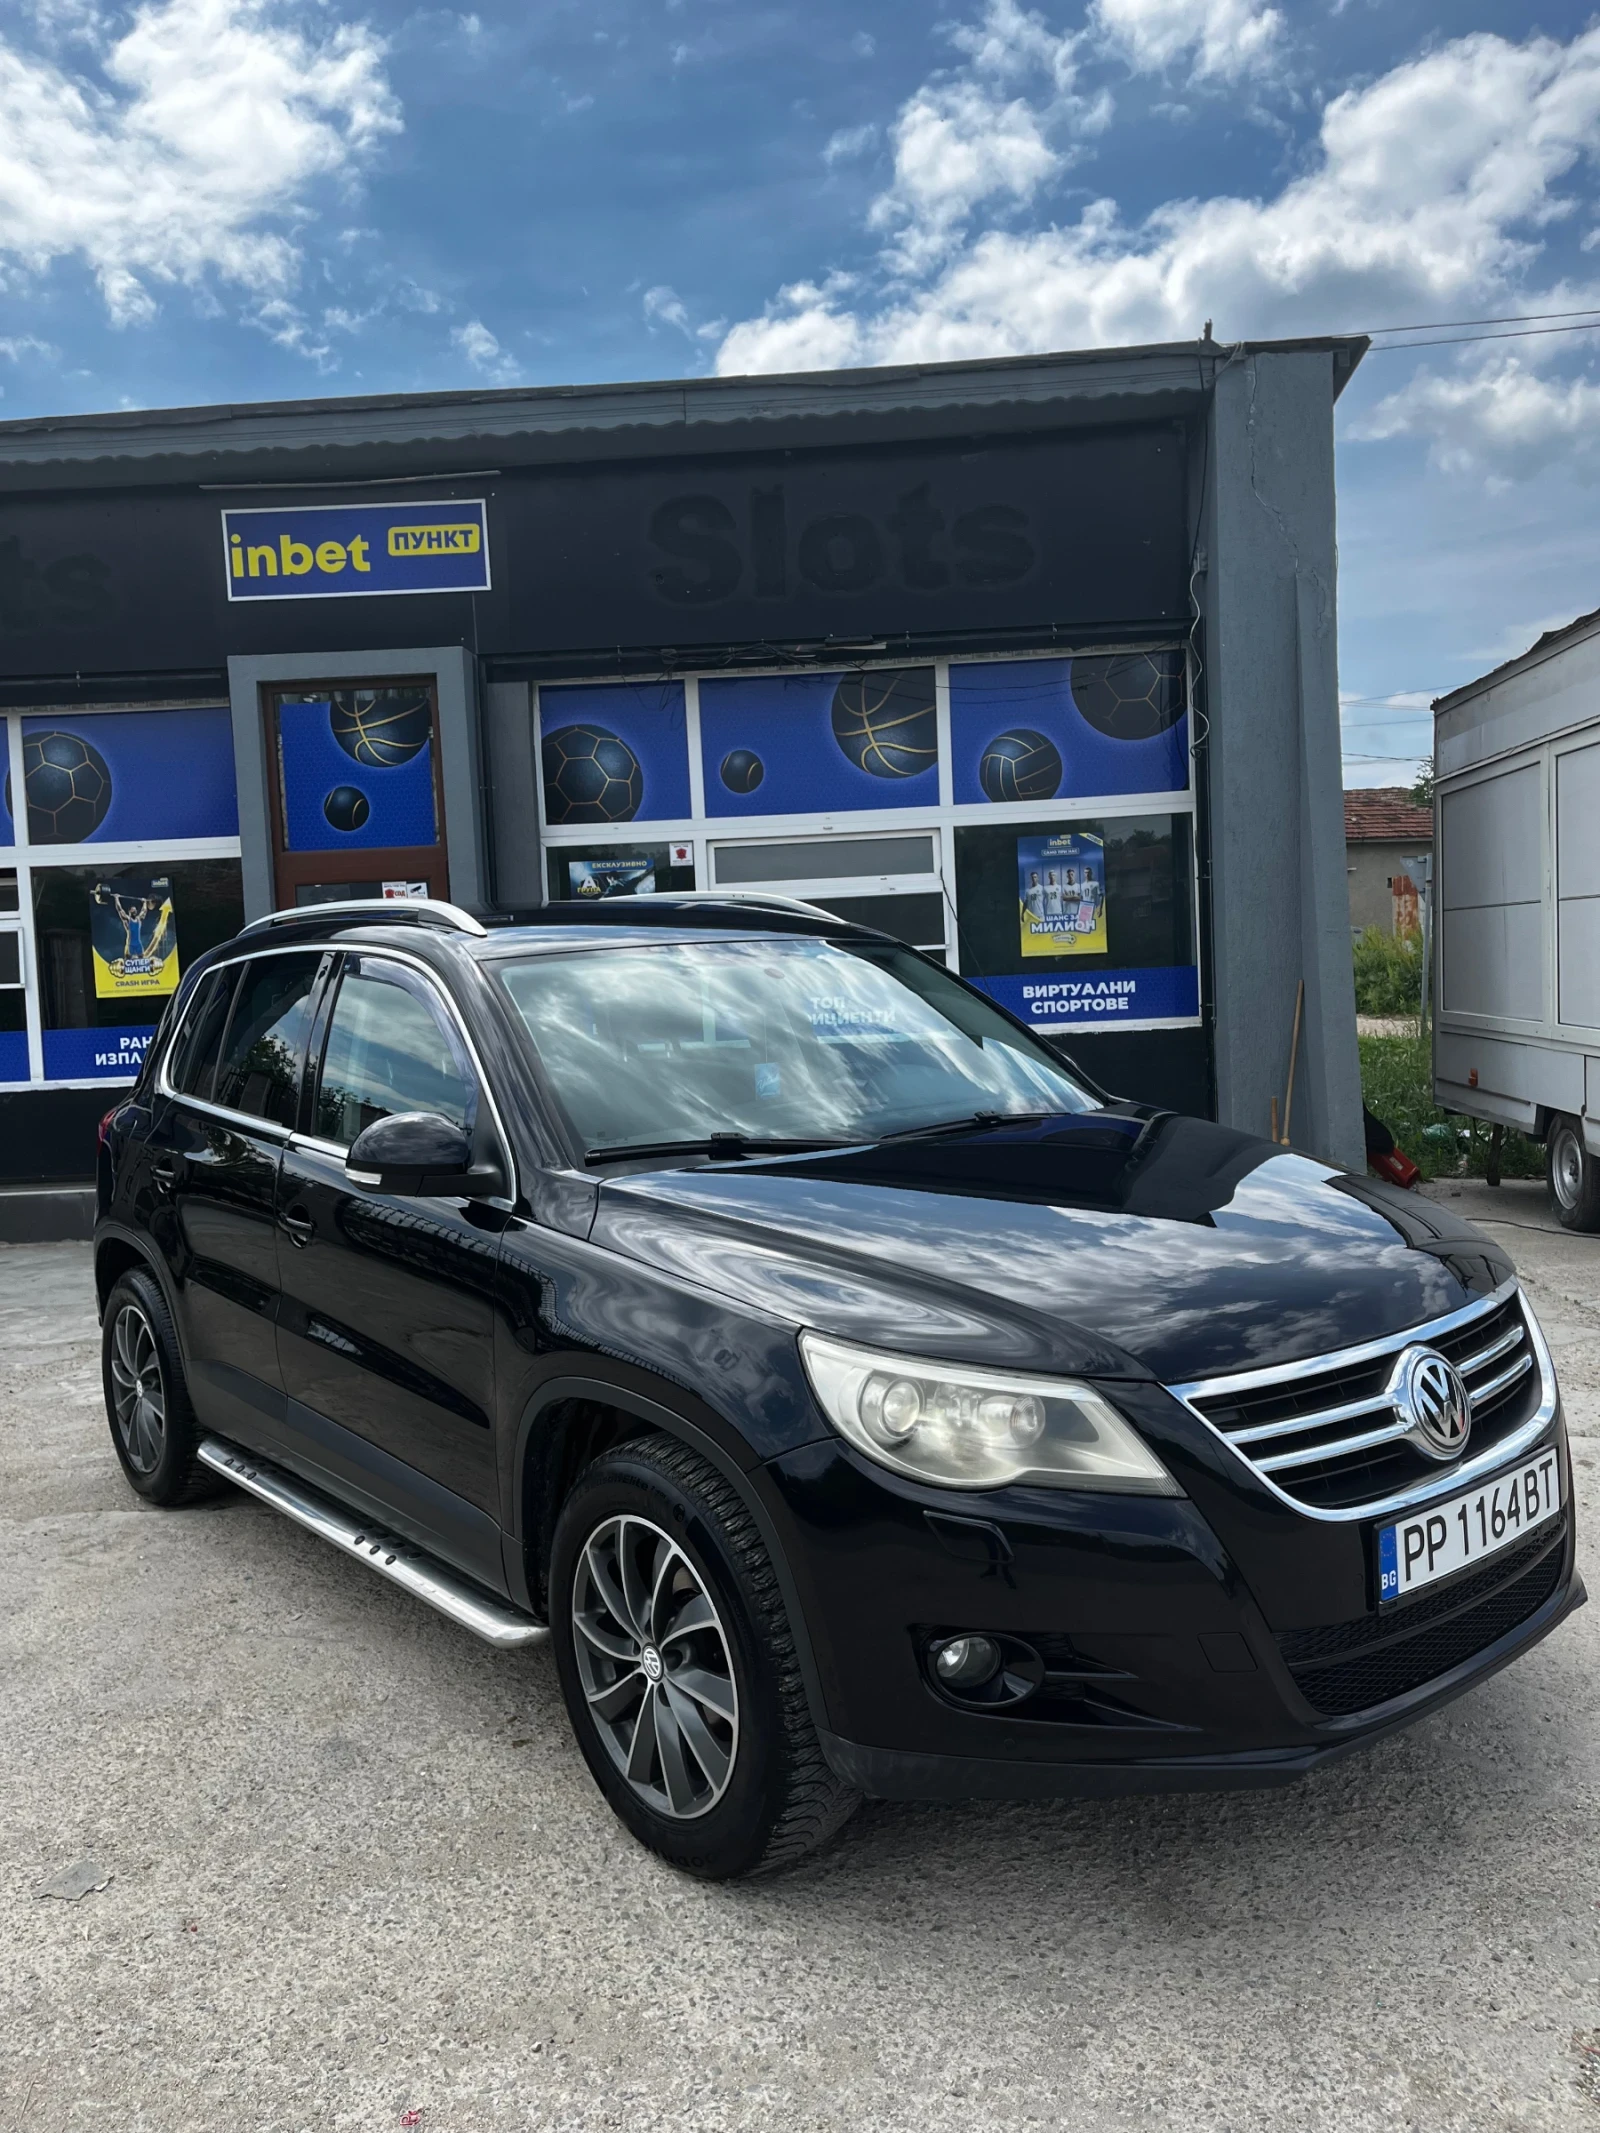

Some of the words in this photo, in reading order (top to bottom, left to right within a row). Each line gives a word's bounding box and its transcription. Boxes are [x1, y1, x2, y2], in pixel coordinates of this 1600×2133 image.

[393, 529, 473, 551] ПУНКТ
[647, 481, 1036, 605] Slots
[231, 533, 371, 578] inbet
[1049, 838, 1071, 847] inbet
[592, 861, 648, 869] ЕКСКЛУЗИВНО
[1031, 920, 1096, 934] МИЛИОН
[125, 959, 150, 967] СУПЕР
[1022, 980, 1136, 999] ВИРТУАЛНИ
[810, 996, 845, 1010] ТОП
[1030, 997, 1129, 1014] СПОРТОВЕ
[1403, 1514, 1447, 1583] PP
[1381, 1569, 1397, 1590] BG
